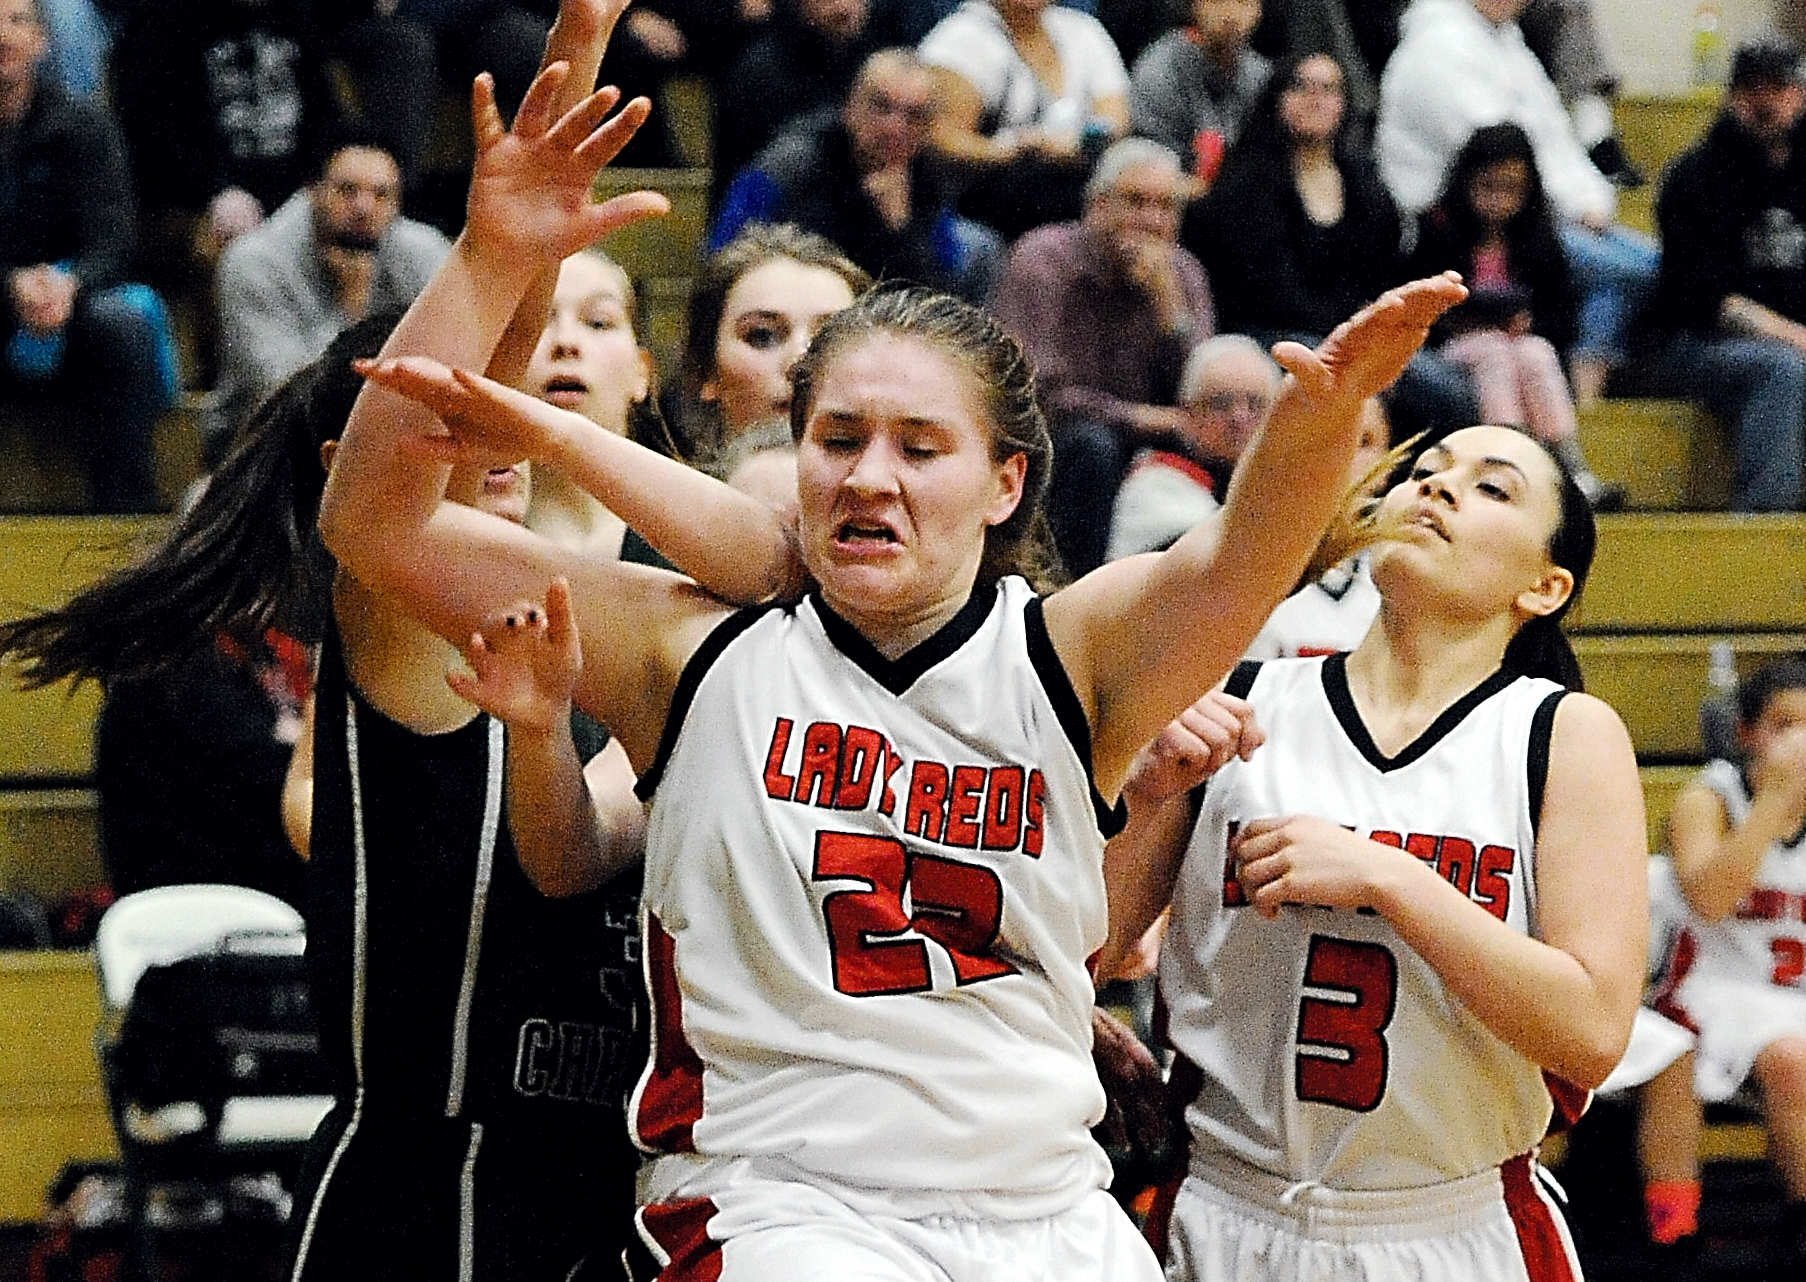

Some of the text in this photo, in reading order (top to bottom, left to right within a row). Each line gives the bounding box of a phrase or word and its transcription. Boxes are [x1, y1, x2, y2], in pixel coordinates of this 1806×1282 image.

[762, 716, 1047, 860] LADY REDS
[811, 829, 1023, 998] 22
[1295, 932, 1398, 1114] 3
